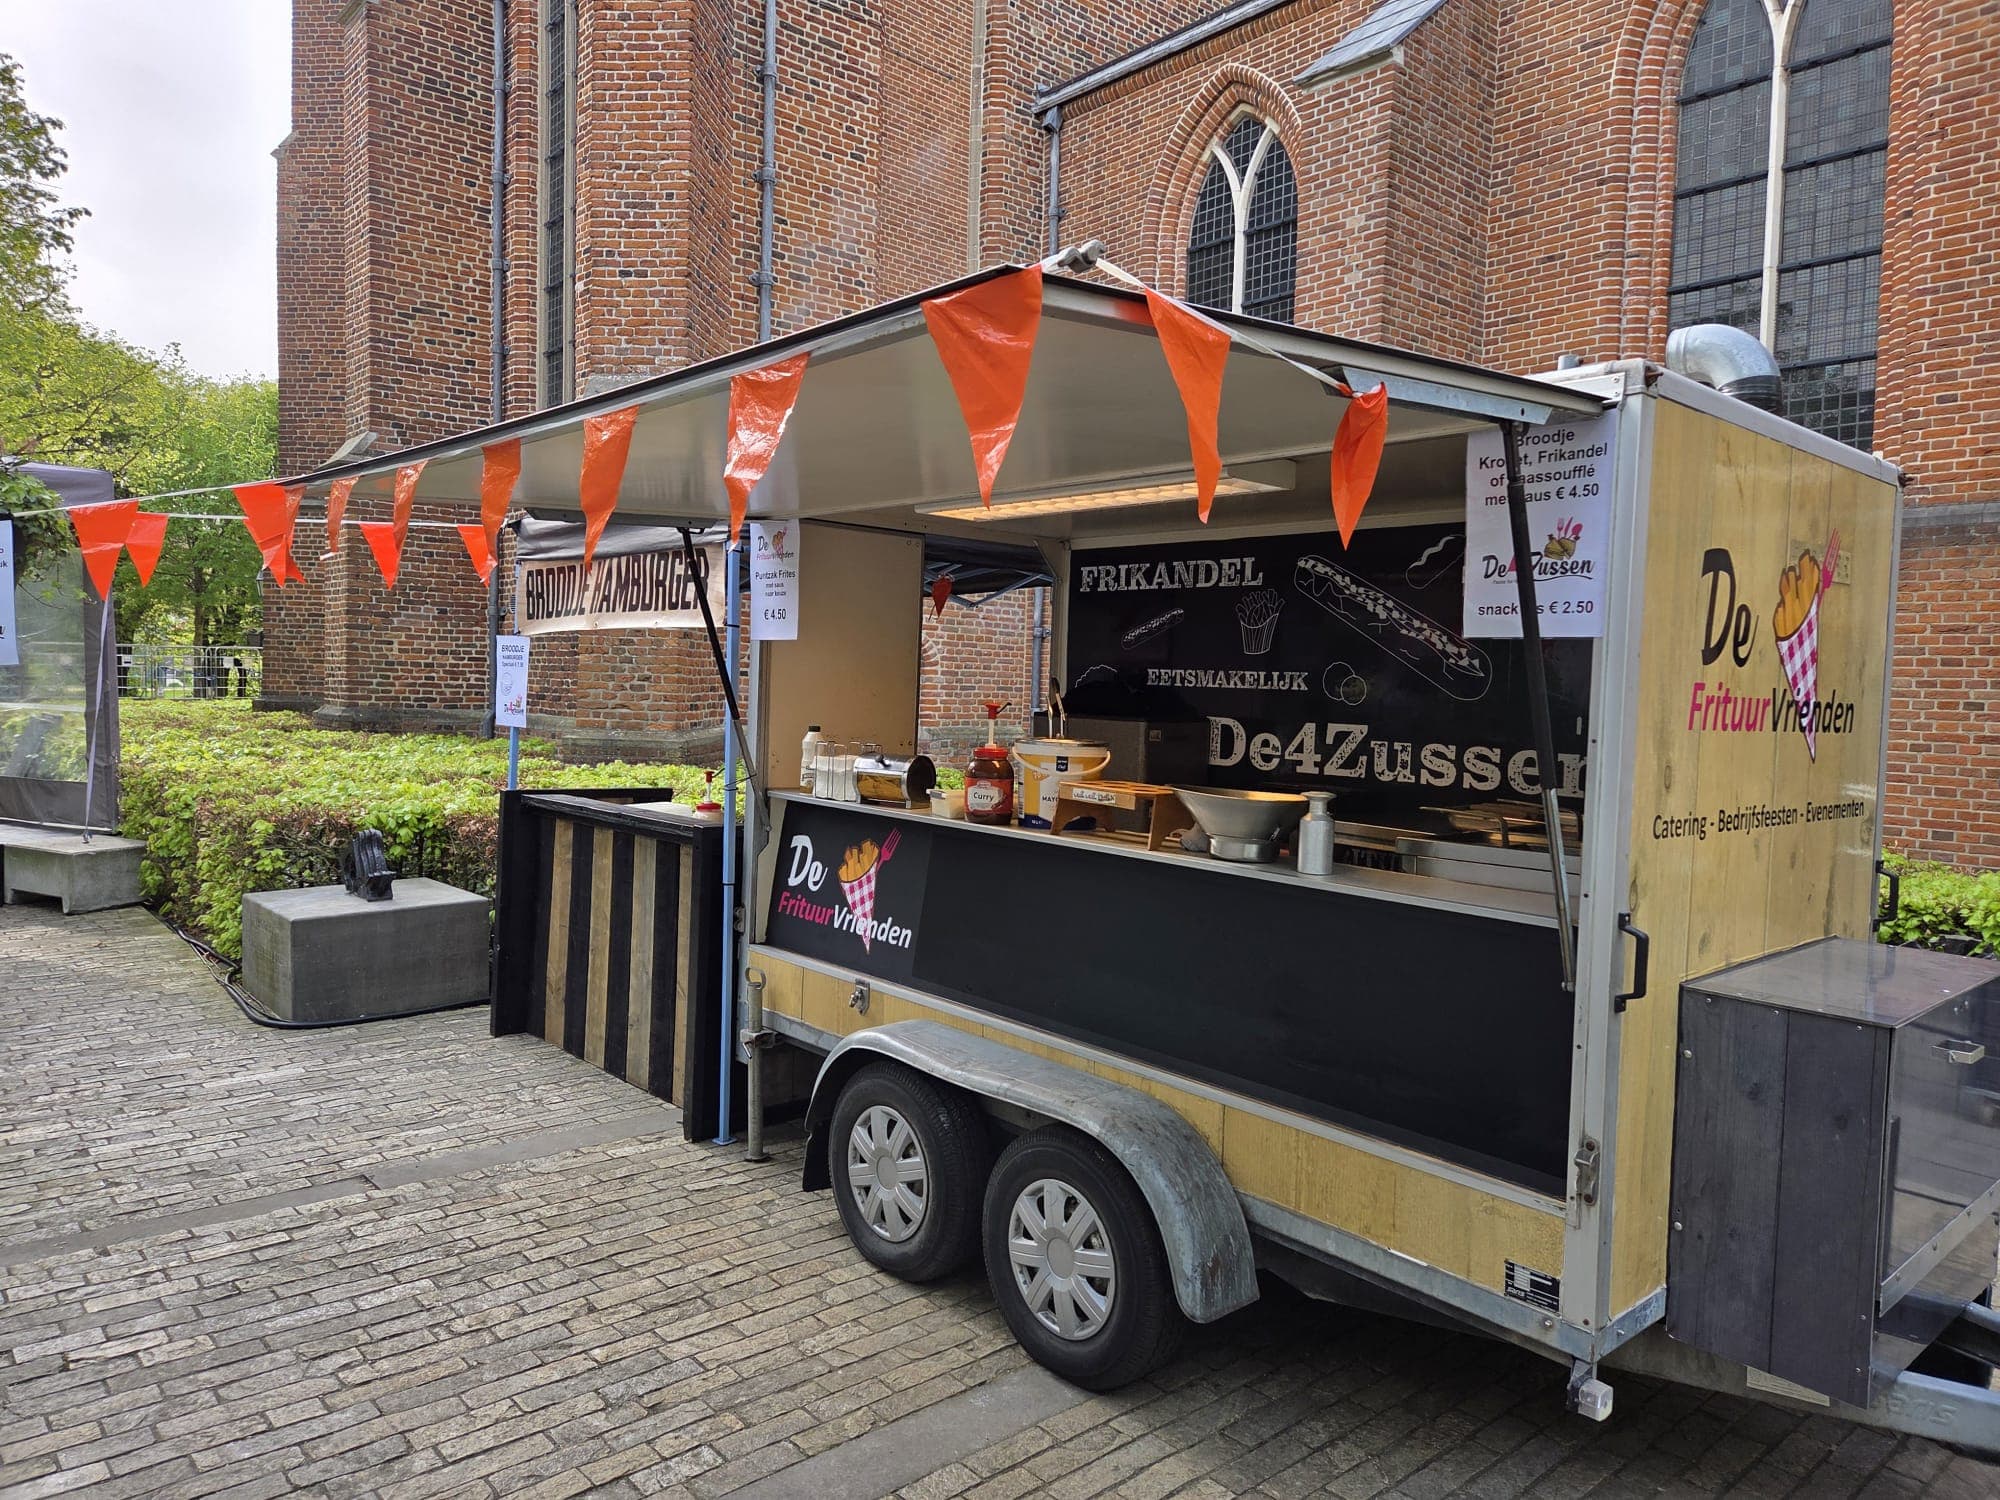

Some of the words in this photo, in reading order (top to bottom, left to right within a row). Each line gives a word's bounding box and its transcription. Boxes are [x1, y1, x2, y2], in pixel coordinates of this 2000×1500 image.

[1516, 430, 1575, 447] Broodje
[1479, 453, 1533, 470] Kroet,
[1537, 442, 1608, 465] Frikandel
[1490, 473, 1505, 487] of
[1517, 463, 1596, 485] aassoufflé
[1485, 494, 1510, 507] me
[1524, 490, 1551, 503] aus
[1569, 483, 1599, 499] 4.50
[757, 535, 769, 552] De
[589, 547, 710, 615] HAMBURGER
[778, 569, 796, 579] Frites
[1079, 556, 1264, 593] FRIKANDEL
[770, 608, 787, 620] 4.50
[1562, 600, 1594, 614] 2.50
[1701, 547, 1760, 668] De
[1146, 668, 1311, 692] EETSMAKELIJK
[1687, 681, 1855, 734] FrituurVrienden
[973, 791, 994, 802] Curry
[1652, 811, 1707, 841] Catering
[1717, 805, 1799, 836] Bedrijfsfeesten
[1806, 799, 1865, 823] Evenementen
[787, 834, 829, 892] De
[778, 891, 913, 949] FrituurVrienden
